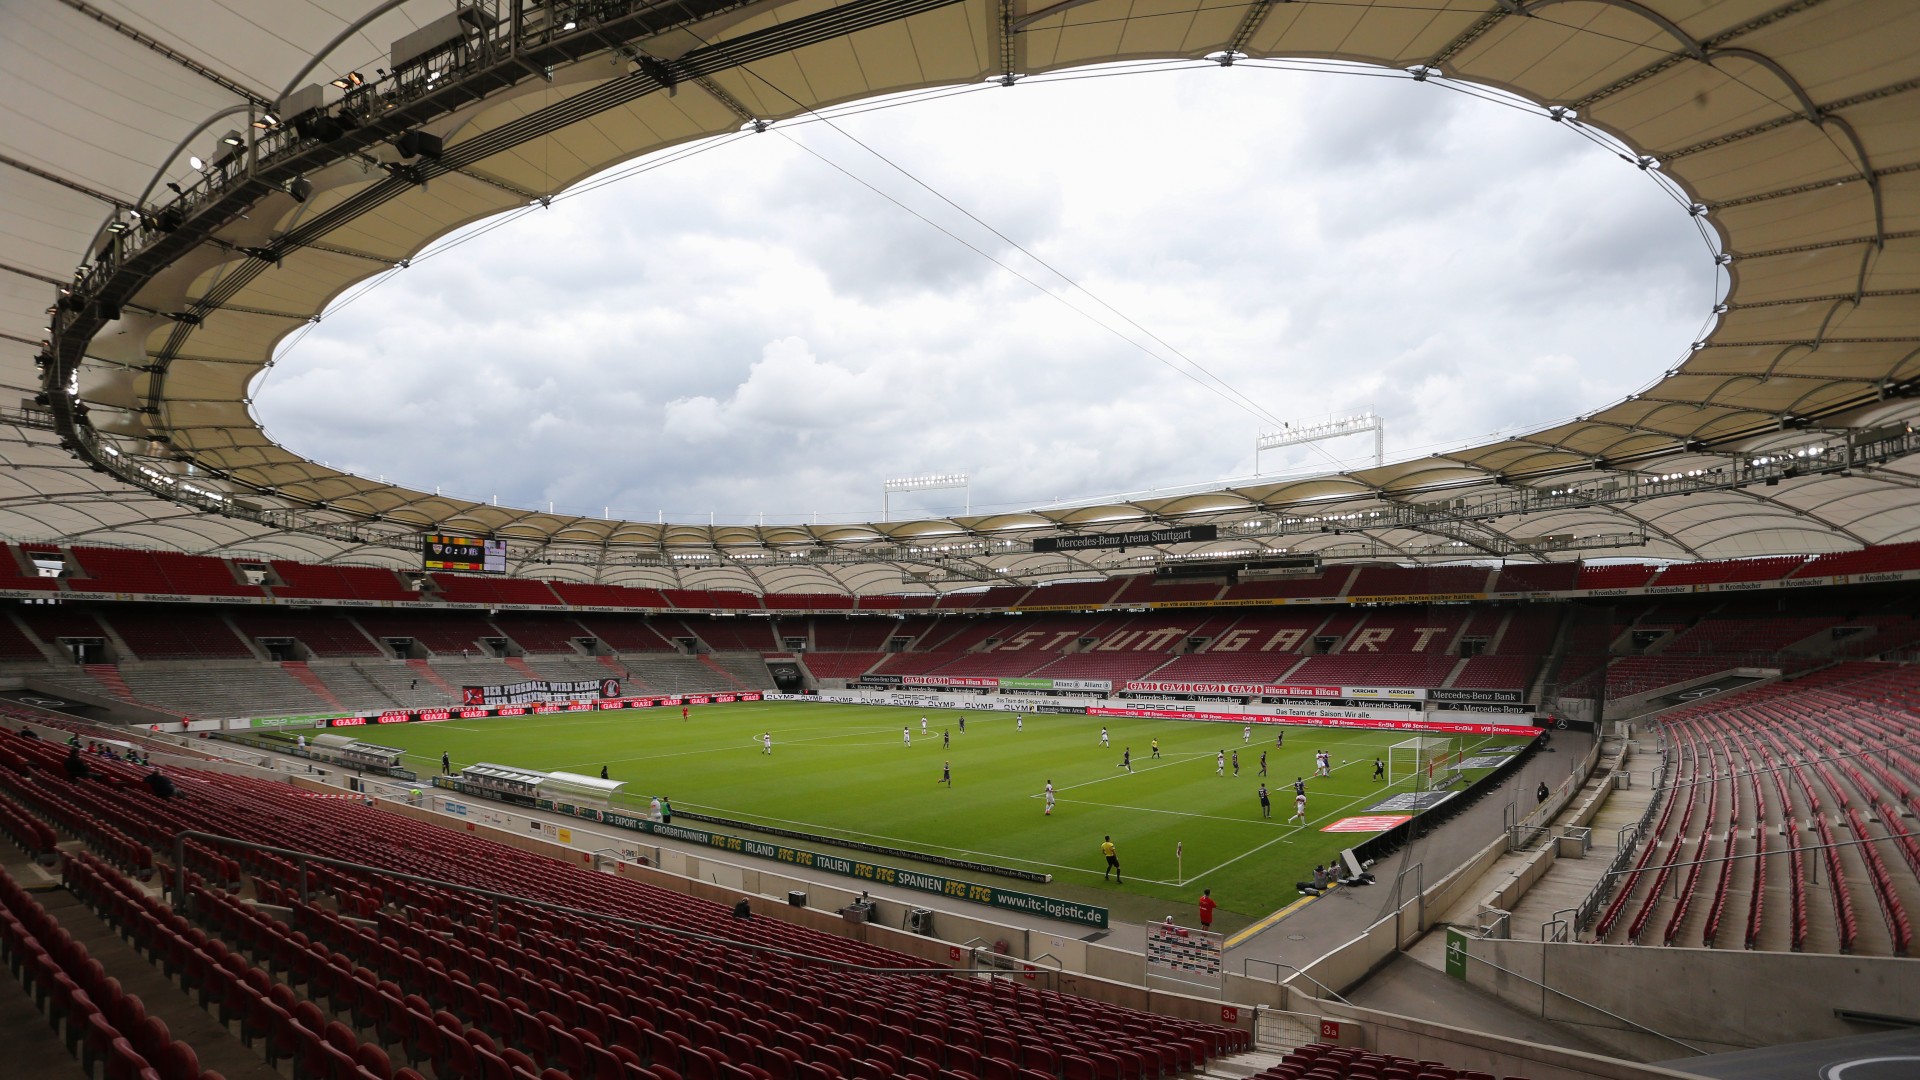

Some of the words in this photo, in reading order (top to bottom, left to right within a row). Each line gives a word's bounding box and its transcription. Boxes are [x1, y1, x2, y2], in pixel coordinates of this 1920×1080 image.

[1056, 536, 1120, 549] Mercedes-Benz
[1122, 533, 1149, 544] Arena
[1151, 529, 1192, 542] Stuttgart
[1865, 573, 1903, 582] Krombacher
[1725, 582, 1761, 591] Krombacher
[61, 592, 105, 600] Krombacher
[483, 686, 501, 696] DER
[504, 681, 548, 695] FUSSBALL
[550, 682, 573, 692] WIRD
[484, 696, 508, 705] EUER
[1433, 690, 1492, 700] Mercedes-Benz
[1494, 692, 1516, 701] Bank
[1126, 703, 1196, 711] PORSCHE
[1463, 704, 1524, 713] Mercedes-Benz
[1357, 711, 1372, 719] alle.
[615, 817, 637, 829] EXPORT
[653, 824, 708, 843] GROßBRITANNIEN
[745, 841, 774, 857] IRLAND
[817, 855, 850, 873] ITALIEN
[994, 867, 1031, 879] Mercedes-Benz
[898, 872, 942, 892] SPANIEN
[997, 893, 1102, 923] www.itc-logistic.de
[1223, 1009, 1236, 1021] 3b
[1323, 1025, 1337, 1036] 3a
